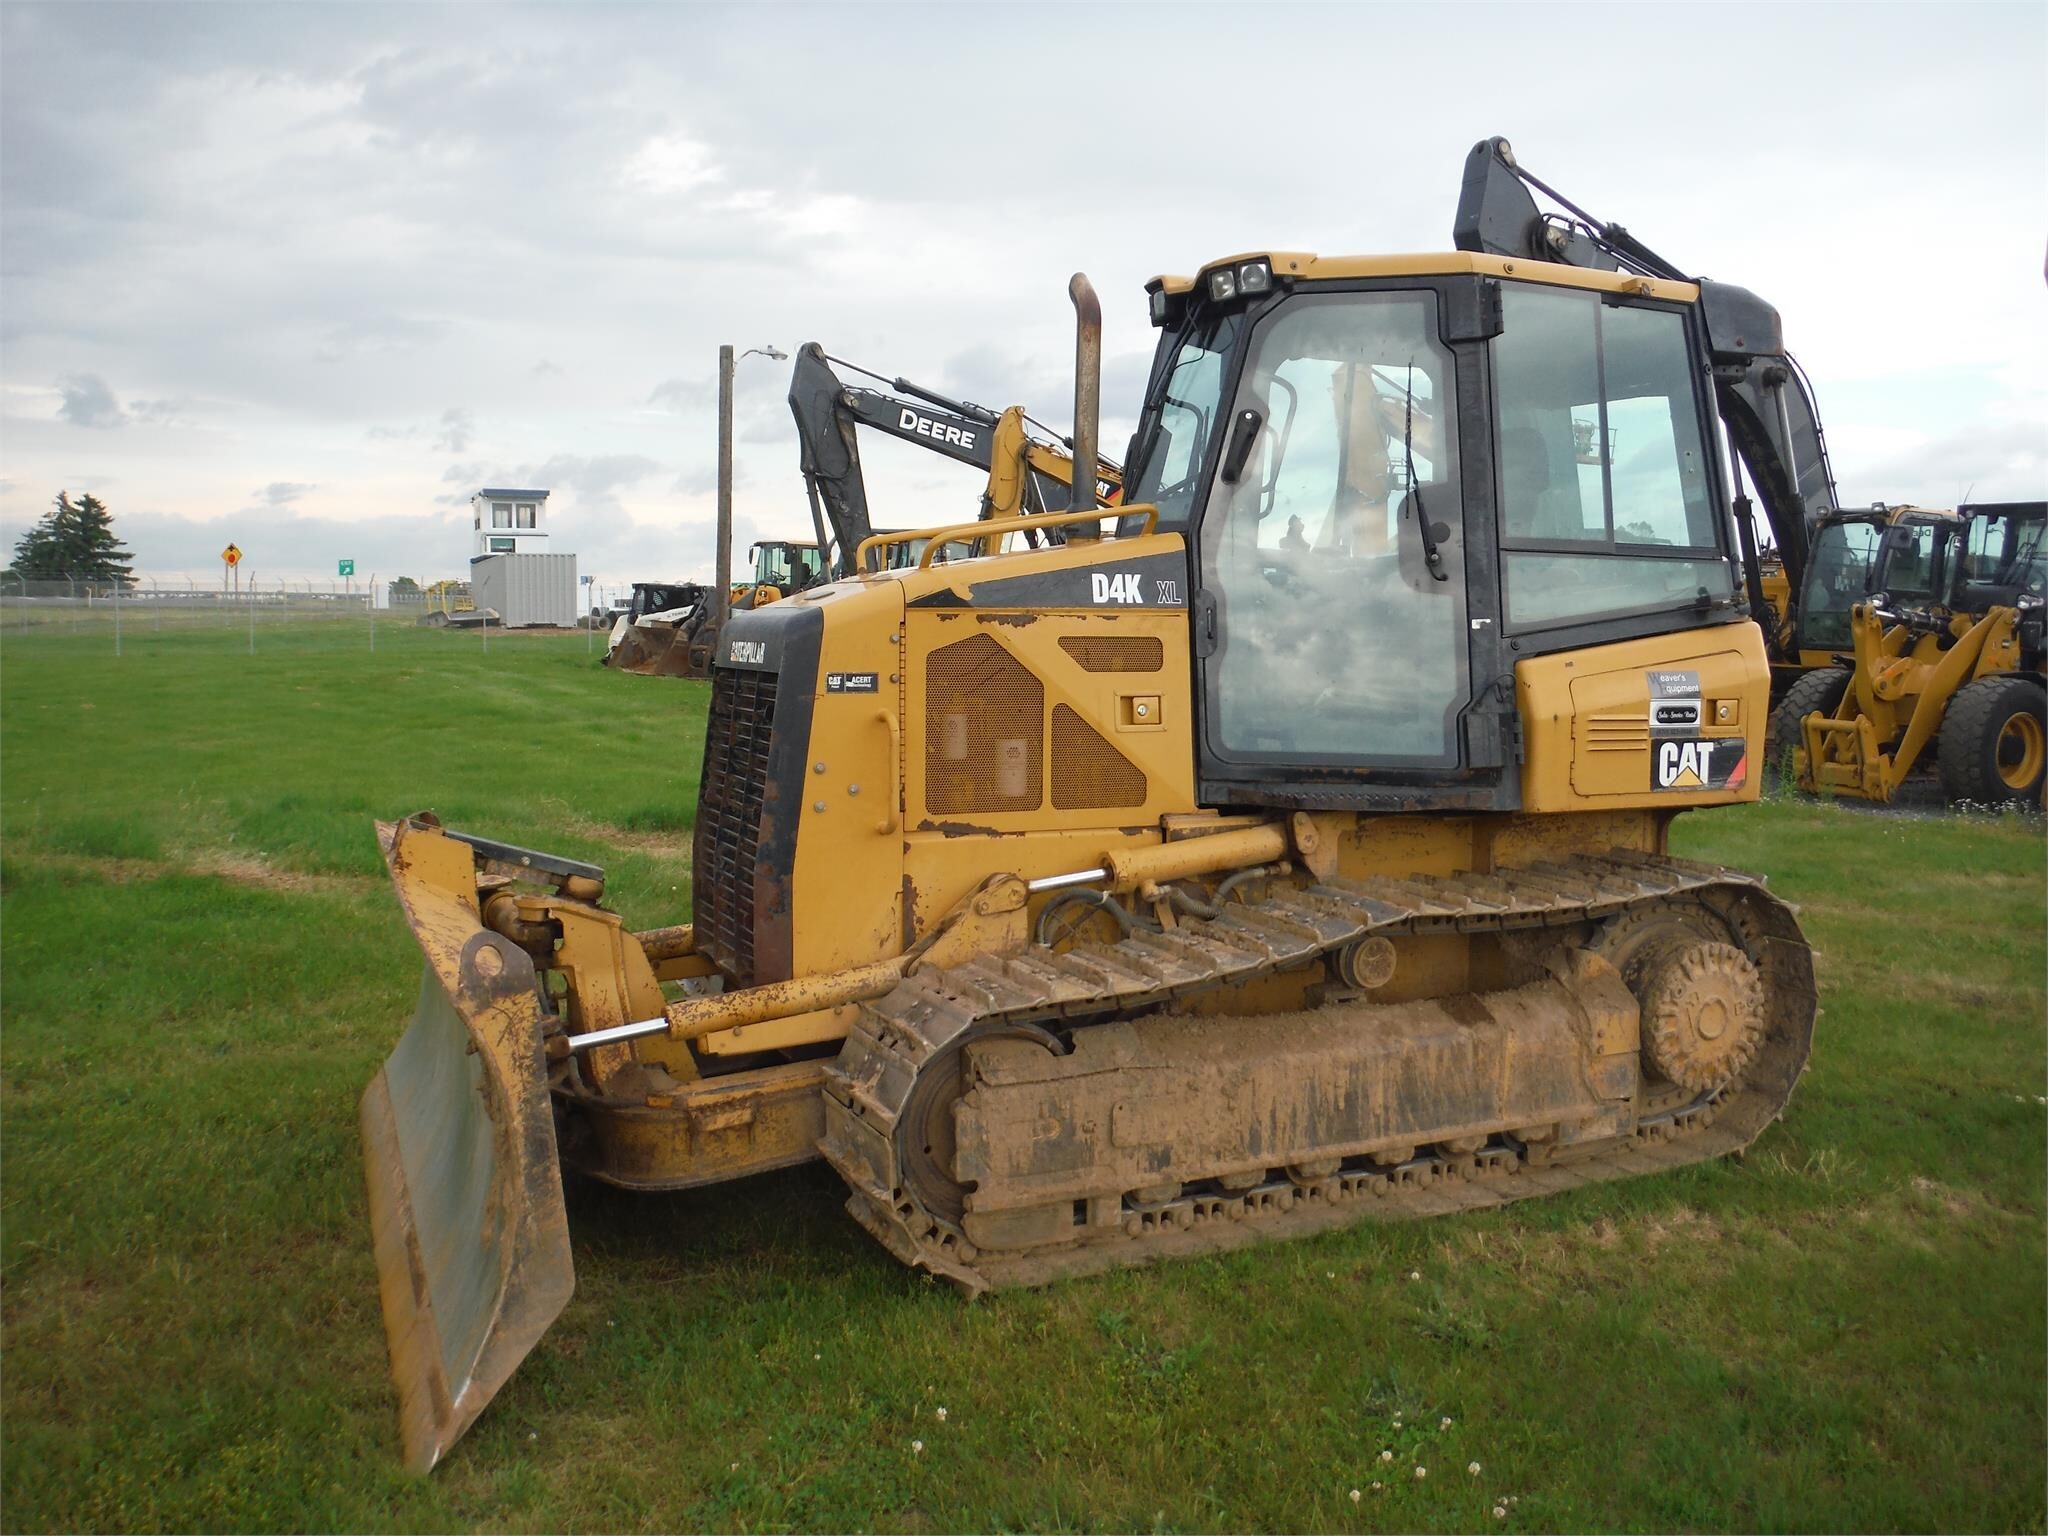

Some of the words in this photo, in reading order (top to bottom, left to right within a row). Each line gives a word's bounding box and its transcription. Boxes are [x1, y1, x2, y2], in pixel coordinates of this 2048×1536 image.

[899, 408, 976, 449] DEERE
[1096, 479, 1111, 498] AT
[1091, 573, 1144, 604] D4K
[1156, 580, 1182, 604] XL
[730, 640, 766, 664] CATERPILLAR
[828, 676, 842, 685] CAT
[1658, 741, 1715, 787] CAT
